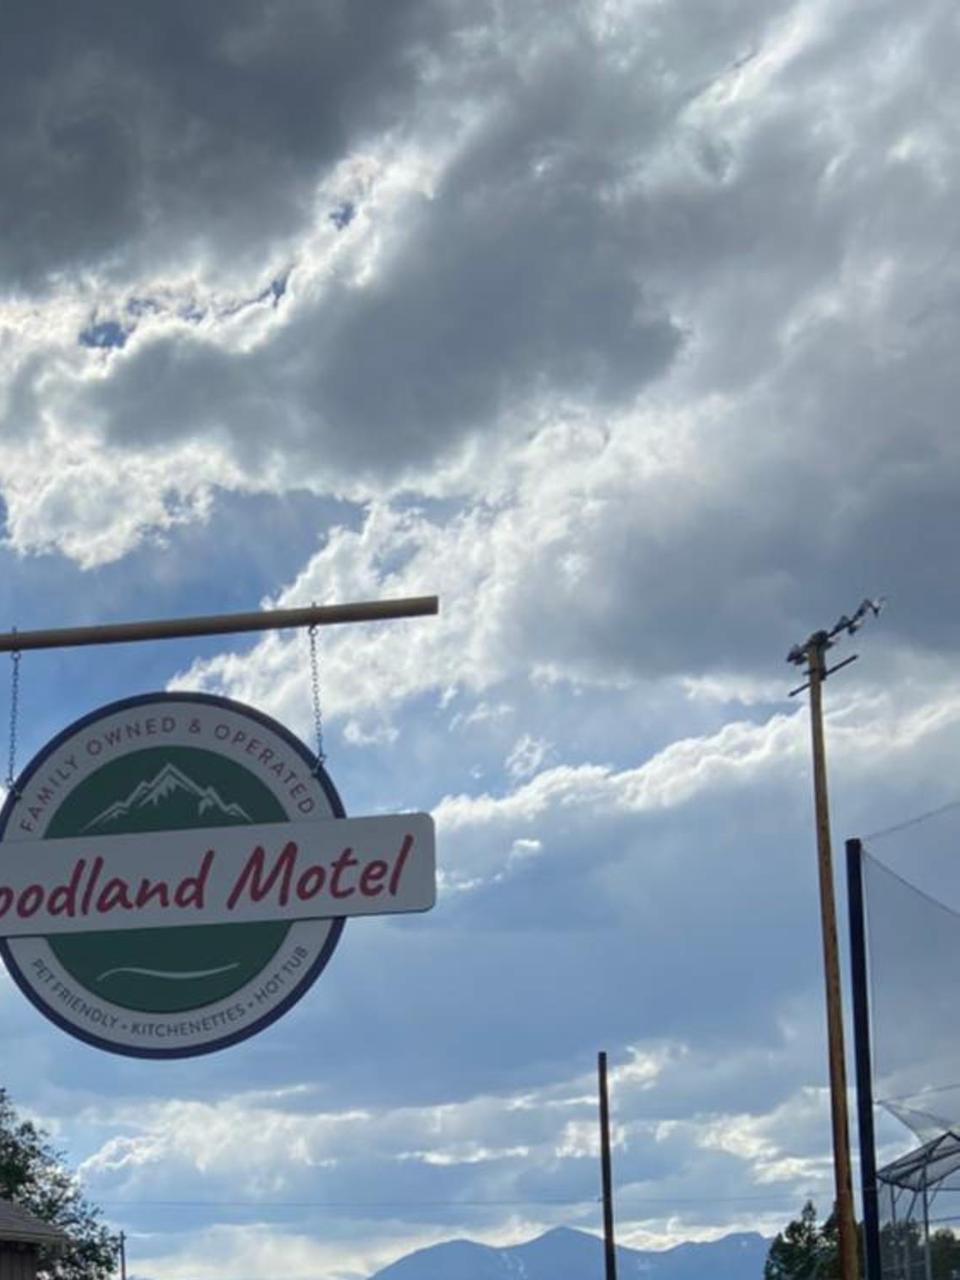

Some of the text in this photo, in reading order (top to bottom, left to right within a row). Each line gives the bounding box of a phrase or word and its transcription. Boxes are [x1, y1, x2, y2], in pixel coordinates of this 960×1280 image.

[19, 716, 315, 832] FAMILY OWNED & OPERATED
[228, 834, 414, 911] Motel
[31, 946, 308, 1037] PET FRIENDLY KITCHENETTES HOT TUB
